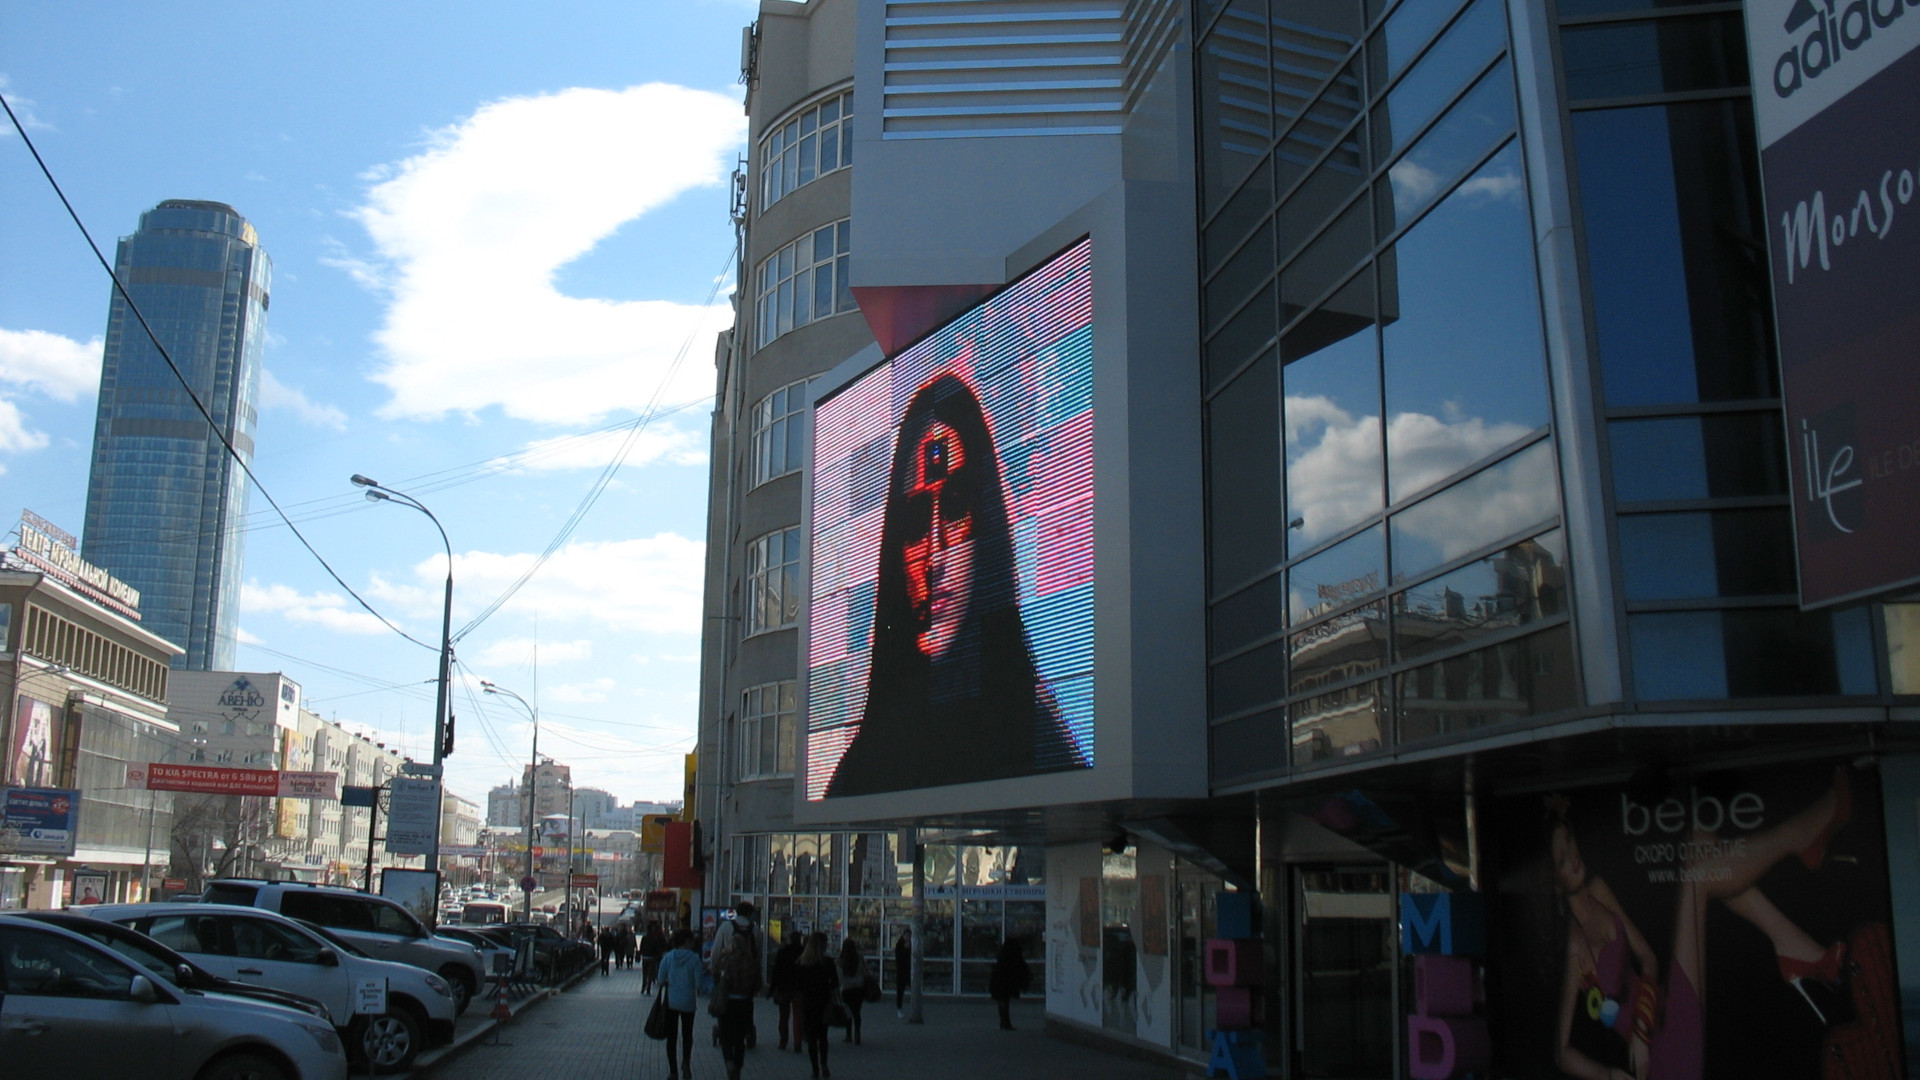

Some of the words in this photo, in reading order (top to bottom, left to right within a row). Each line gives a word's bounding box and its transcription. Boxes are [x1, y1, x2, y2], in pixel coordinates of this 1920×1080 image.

[1773, 0, 1920, 98] adida
[1782, 168, 1920, 284] Monso
[21, 524, 51, 560] ТЕАТР
[218, 692, 265, 707] АВЕНЮ
[165, 769, 181, 777] KIA
[182, 770, 219, 780] SPECTRA
[1620, 786, 1765, 835] bebe
[1634, 843, 1675, 864] СКОРО
[1679, 838, 1747, 862] ОТКРЫТИЕ
